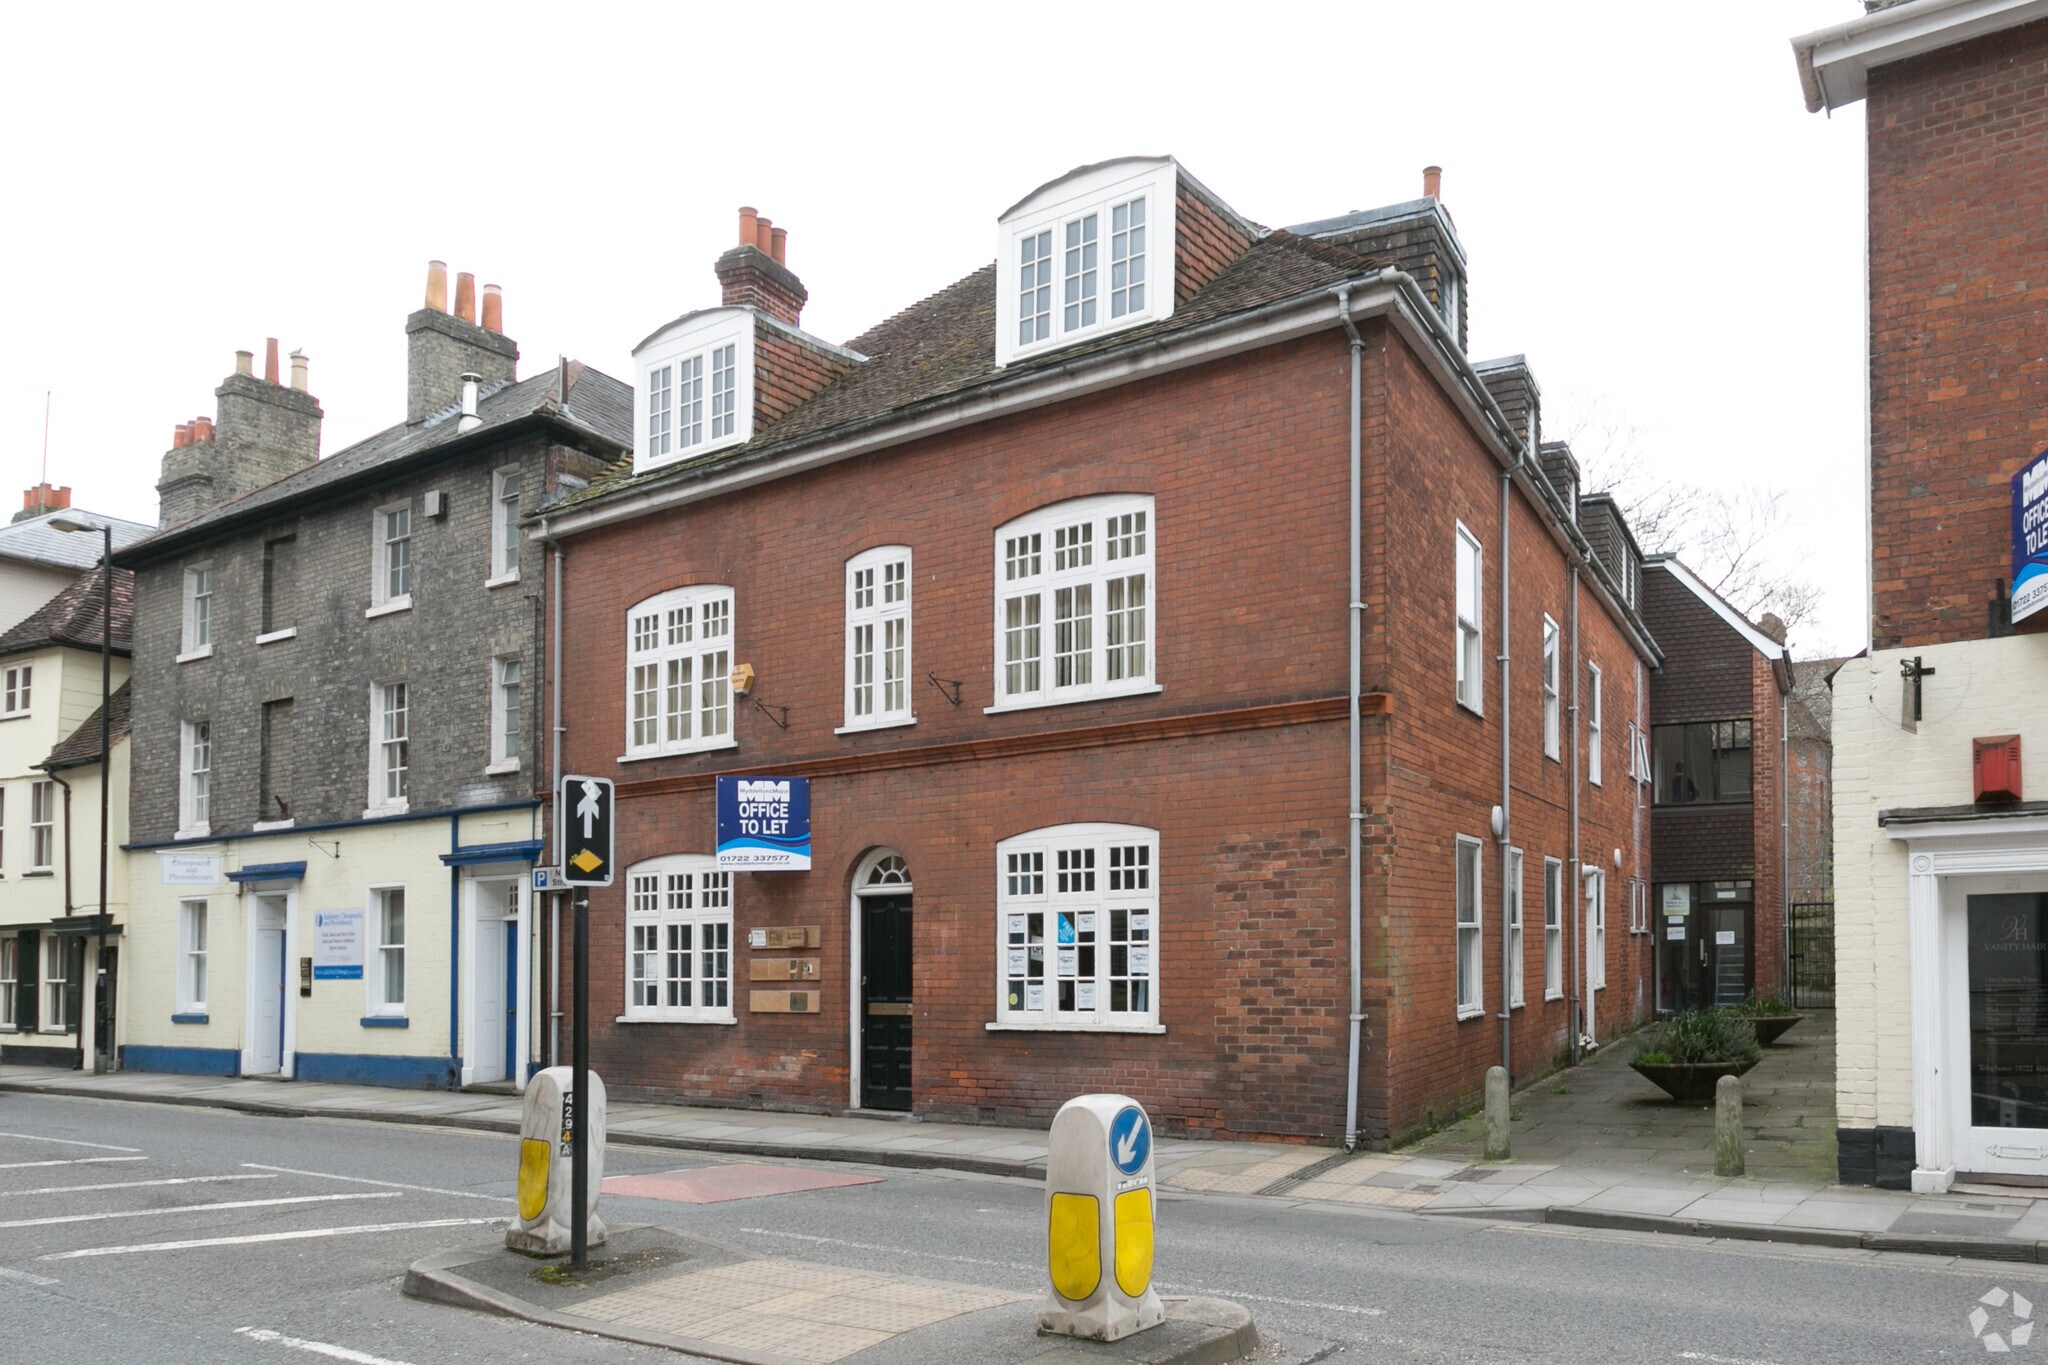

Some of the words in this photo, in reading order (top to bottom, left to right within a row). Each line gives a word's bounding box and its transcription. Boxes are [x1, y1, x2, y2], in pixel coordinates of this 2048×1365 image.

[2025, 531, 2037, 556] TO
[2037, 521, 2048, 549] LE
[2032, 583, 2048, 599] 3375
[737, 780, 790, 802] MM
[739, 803, 788, 818] OFFICE
[739, 819, 759, 835] TO
[762, 819, 788, 835] LET
[753, 854, 790, 862] 337577
[1984, 943, 2020, 951] VANITY
[2022, 942, 2048, 951] HAIR
